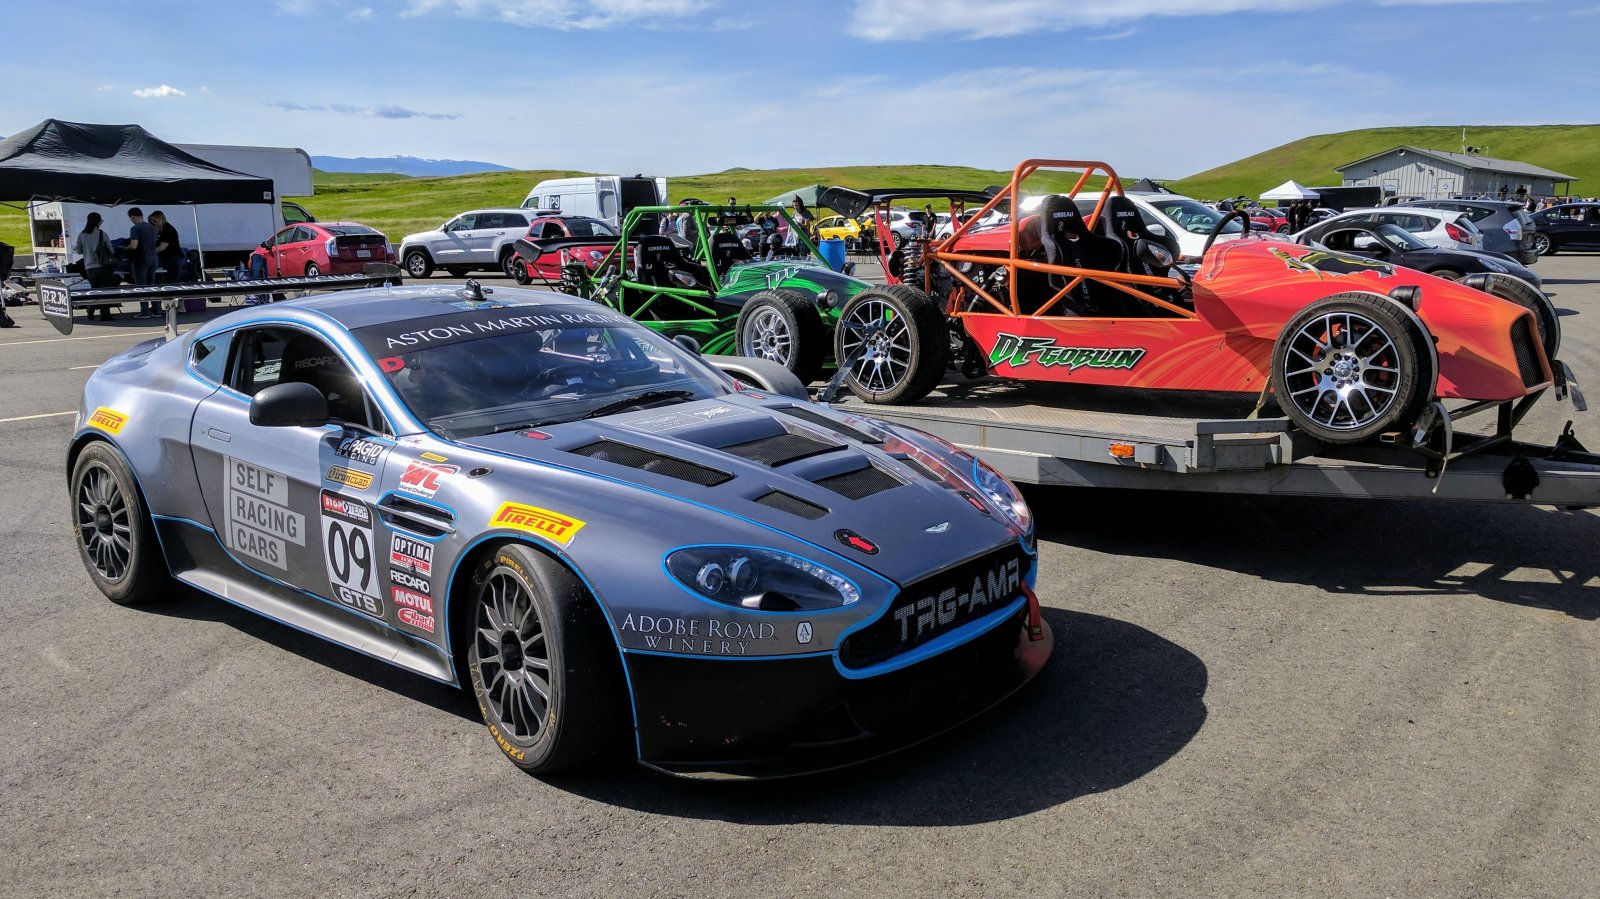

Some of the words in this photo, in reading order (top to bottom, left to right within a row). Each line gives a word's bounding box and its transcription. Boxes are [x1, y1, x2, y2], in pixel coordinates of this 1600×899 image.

[386, 324, 473, 349] ASTON
[474, 314, 562, 333] MARTIN
[564, 312, 634, 325] RACING
[295, 355, 339, 369] RECARO
[336, 450, 376, 465] RACING
[350, 440, 384, 457] PAGID
[236, 463, 274, 495] SELF
[236, 495, 297, 539] RACING
[495, 506, 573, 536] PIRELLI
[237, 529, 279, 563] CARS
[328, 521, 371, 592] 09
[394, 537, 430, 563] OPTIMA
[390, 570, 430, 593] RECARO
[339, 586, 378, 613] GTS
[395, 590, 432, 613] MOTUL
[894, 557, 1019, 641] TRG-AMR
[621, 613, 699, 636] ADOBE
[708, 619, 775, 639] ROAD
[644, 635, 750, 654] WINERY
